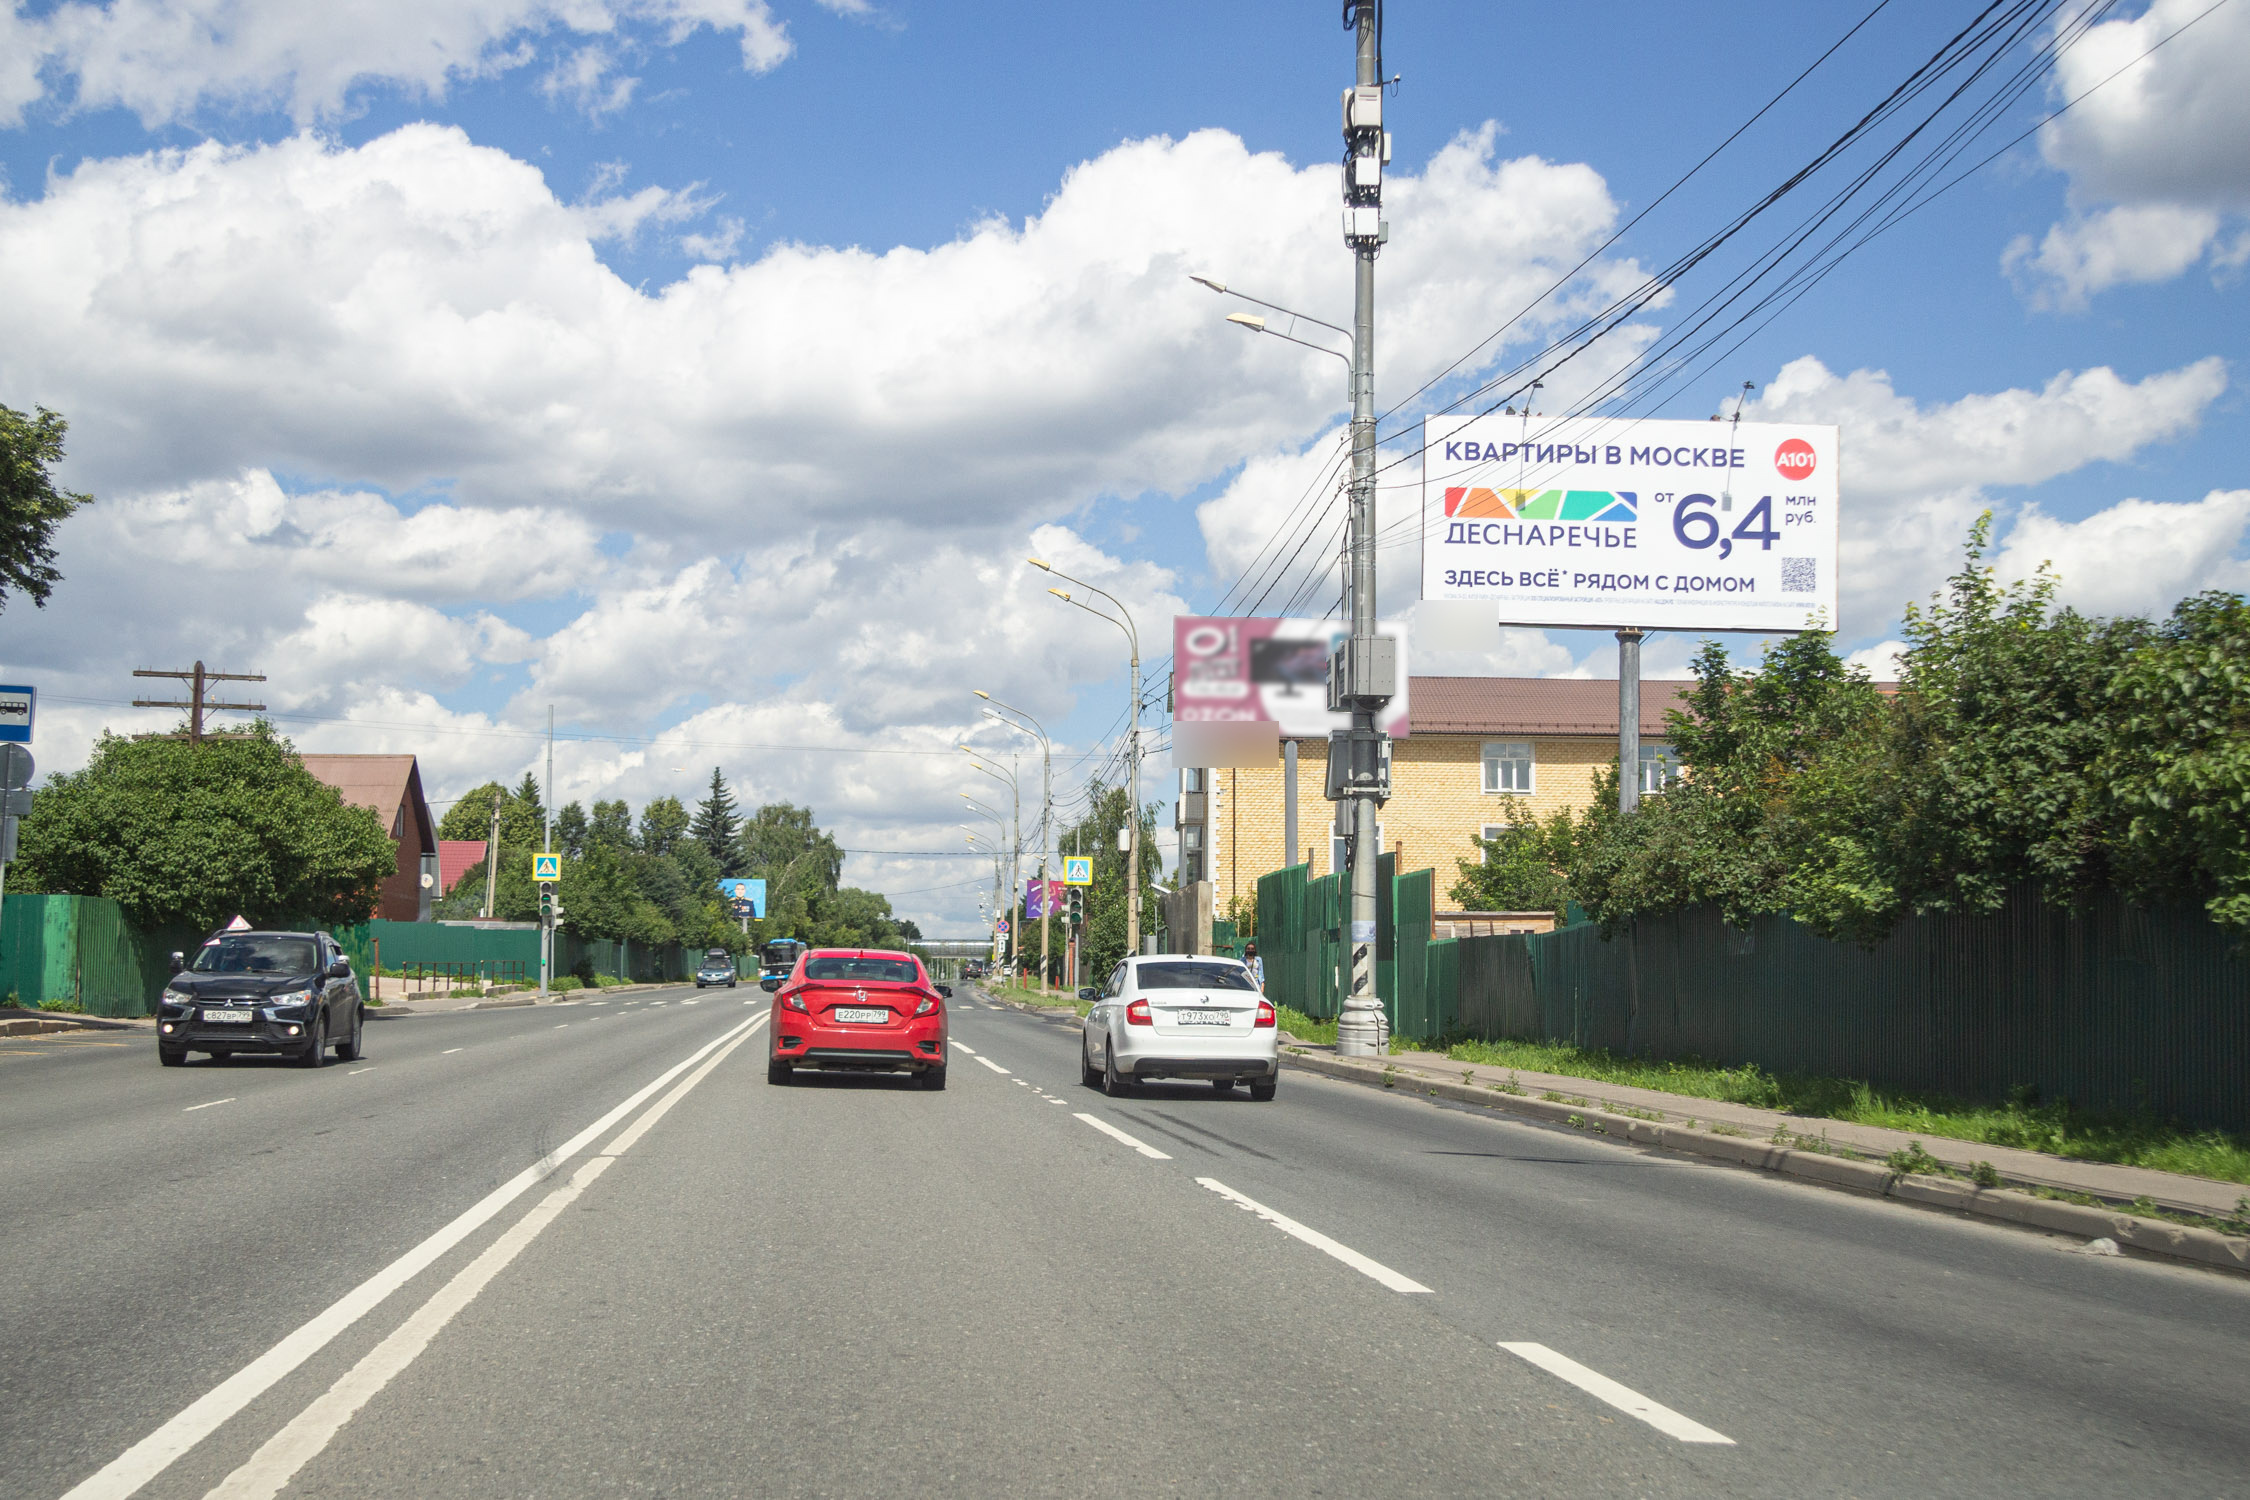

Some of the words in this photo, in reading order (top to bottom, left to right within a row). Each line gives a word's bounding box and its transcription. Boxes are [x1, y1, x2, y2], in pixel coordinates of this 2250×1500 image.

[1445, 441, 1597, 465] КВАРТИРЫ
[1605, 445, 1622, 465] В
[1630, 446, 1745, 468] МОСКВЕ
[1444, 522, 1638, 549] ДЕСНАРЕЧЬЕ
[1673, 493, 1781, 560] 6,4
[1444, 569, 1514, 588] ЗДЕСЬ
[1573, 573, 1649, 592] РЯДОМ
[1655, 575, 1669, 591] С
[1673, 576, 1755, 593] ДОМОМ
